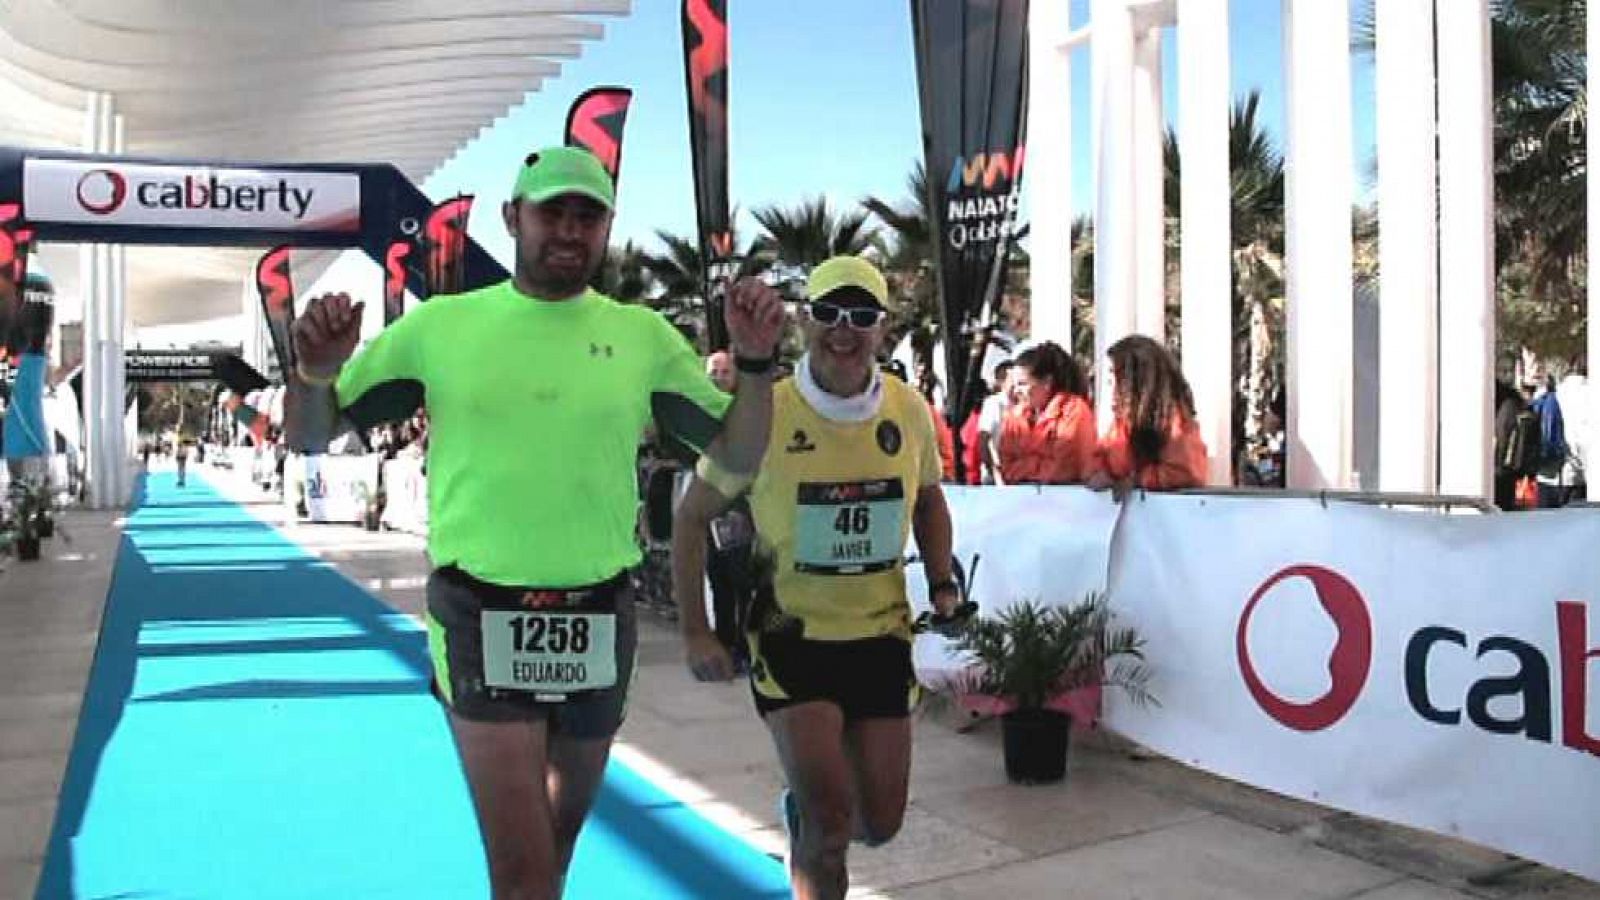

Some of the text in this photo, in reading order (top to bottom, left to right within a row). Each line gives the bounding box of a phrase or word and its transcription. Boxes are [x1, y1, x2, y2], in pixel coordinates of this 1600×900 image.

[137, 175, 314, 218] cabberty
[834, 507, 869, 534] 46
[832, 539, 873, 559] JAVIER
[508, 616, 589, 654] 1258
[512, 661, 587, 684] EDUARDO
